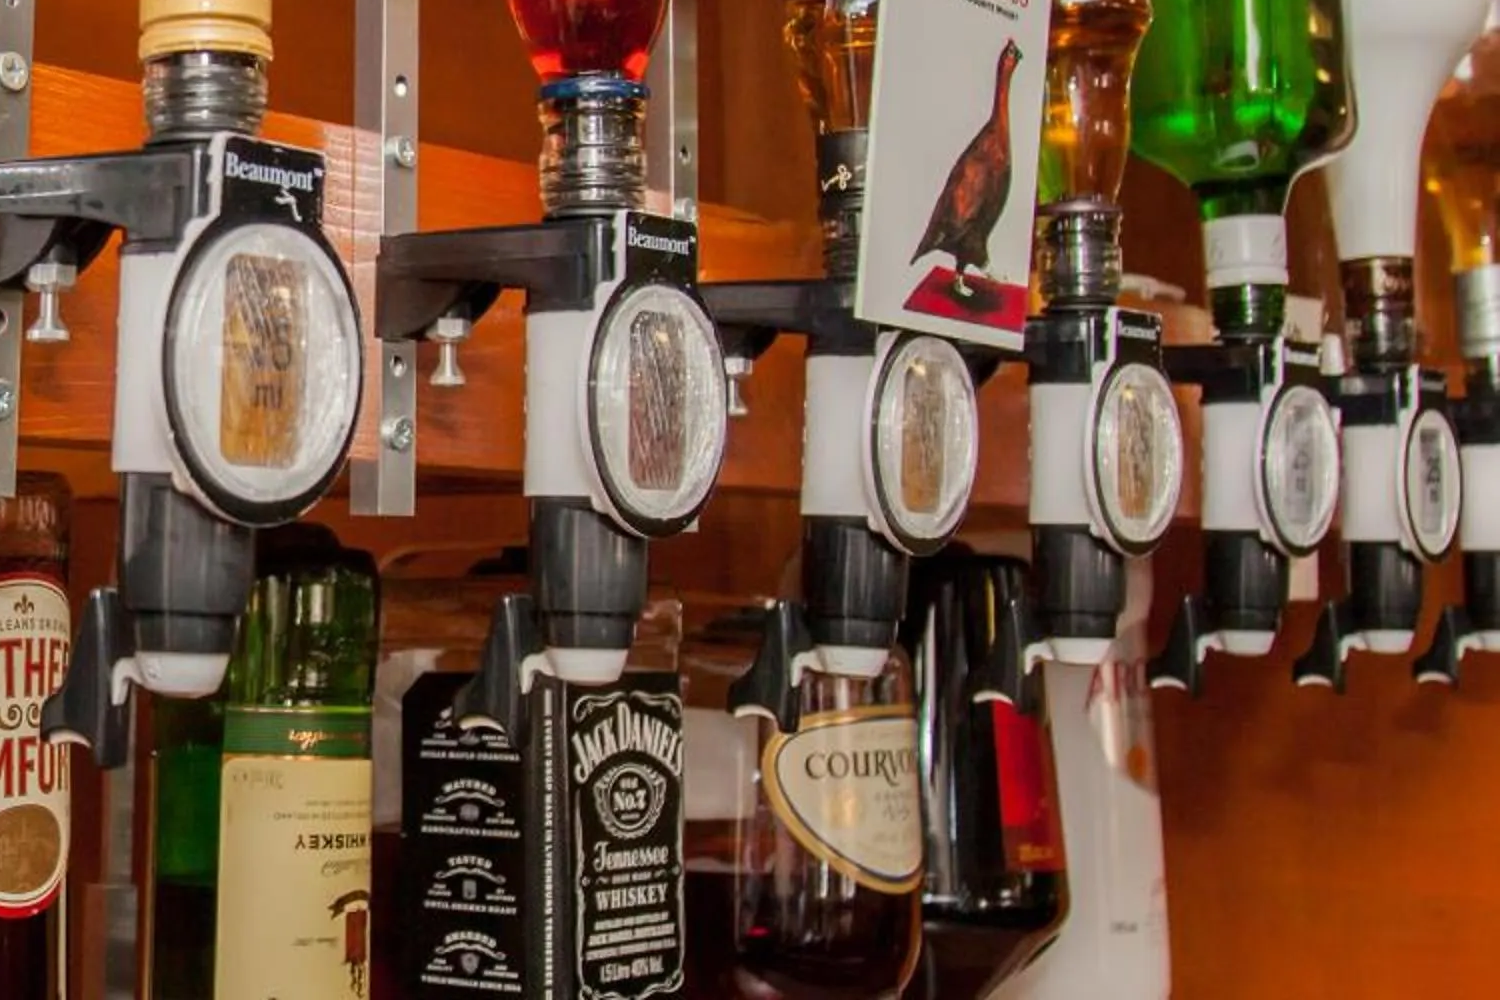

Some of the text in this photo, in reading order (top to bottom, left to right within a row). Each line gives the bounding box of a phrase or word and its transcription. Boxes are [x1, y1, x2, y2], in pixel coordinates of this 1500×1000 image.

[225, 150, 313, 191] Beaumont
[627, 225, 691, 256] Beaumont
[571, 715, 618, 784] JACK
[294, 834, 369, 851] WHISKEY
[593, 840, 670, 872] Tennessee
[595, 882, 669, 911] WHISKEY
